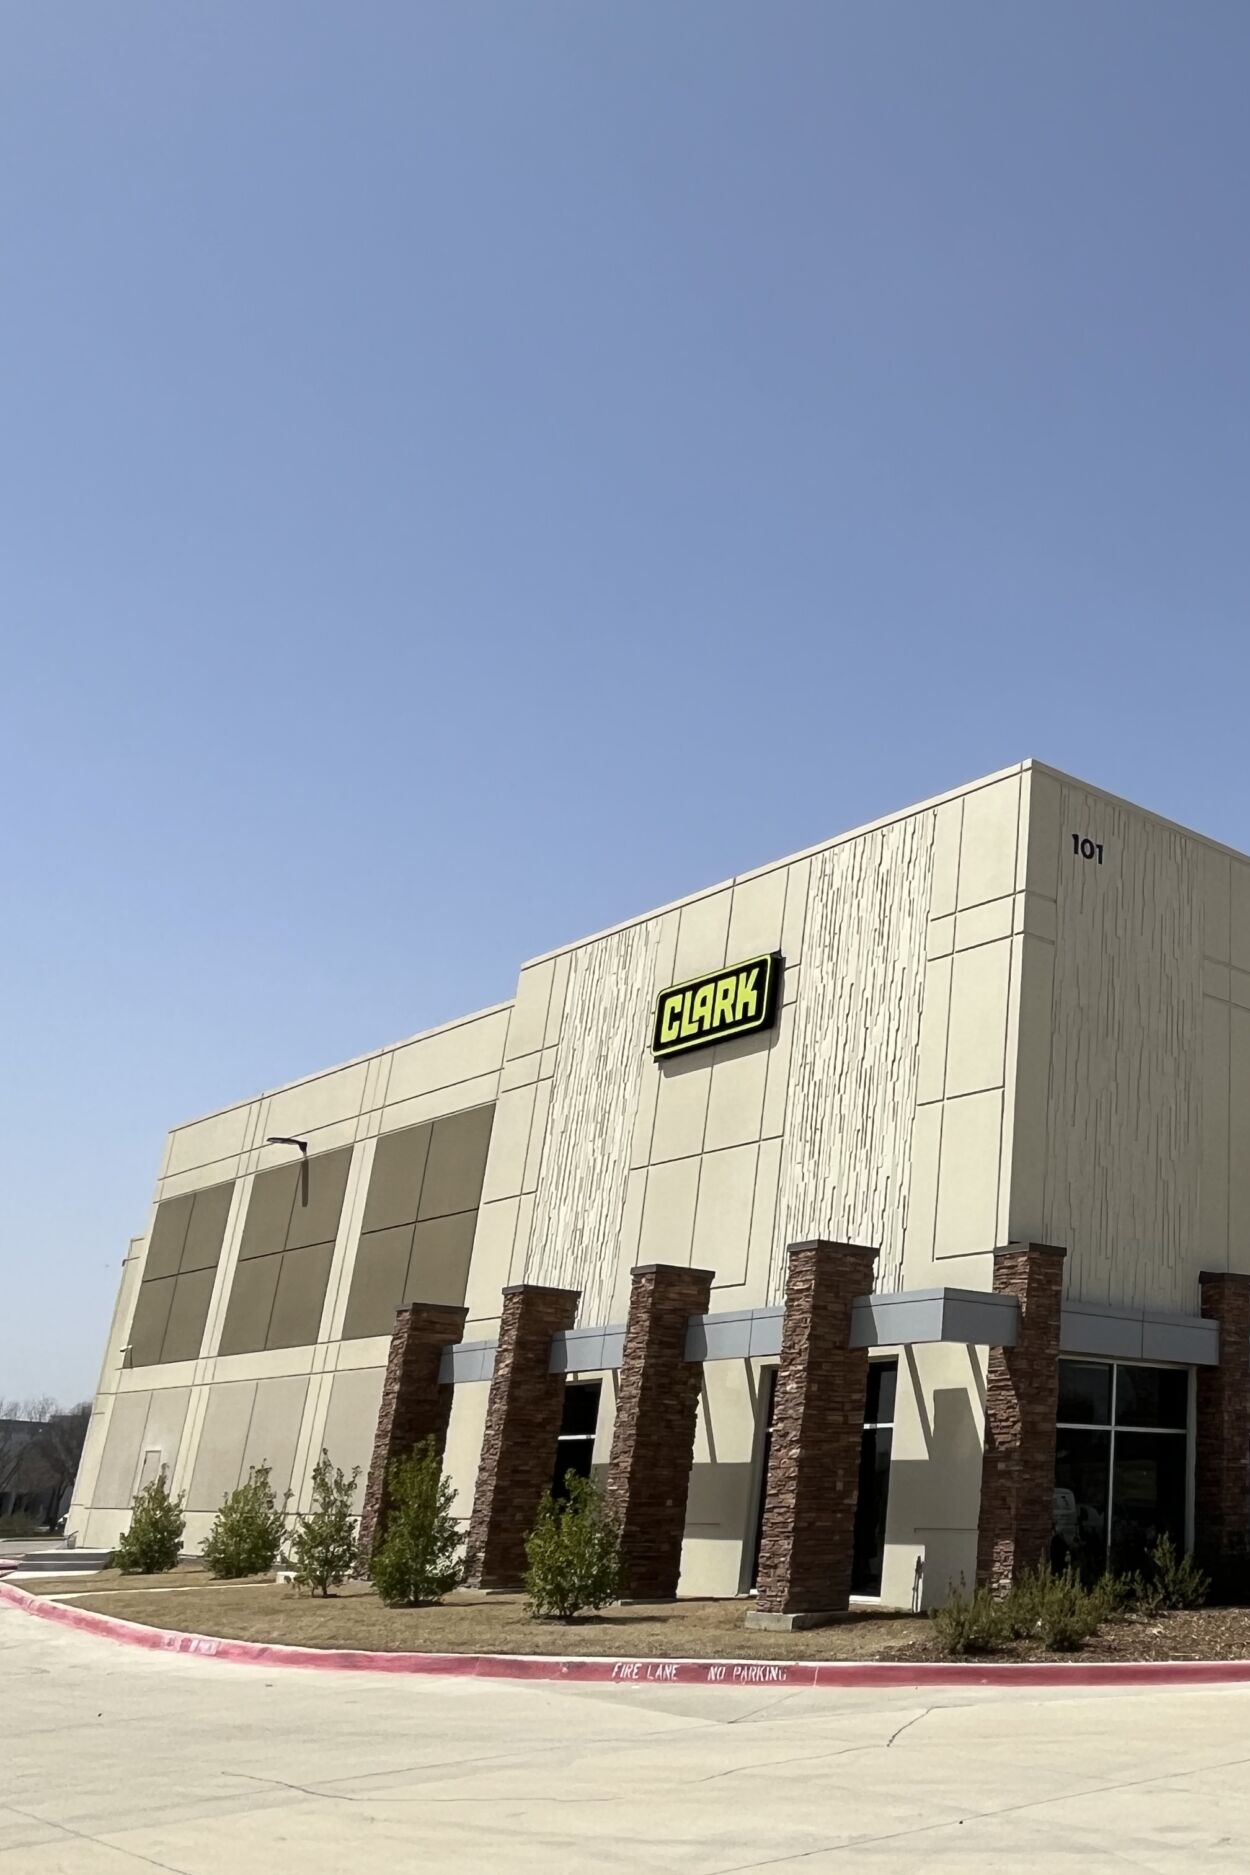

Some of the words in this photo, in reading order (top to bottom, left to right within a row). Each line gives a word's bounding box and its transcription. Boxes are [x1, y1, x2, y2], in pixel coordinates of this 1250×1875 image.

[1072, 833, 1103, 865] 101
[660, 967, 760, 1044] CLARK
[612, 1663, 643, 1679] FIRE
[646, 1664, 681, 1680] LANE
[707, 1665, 726, 1681] NO
[733, 1665, 787, 1682] PARKING
